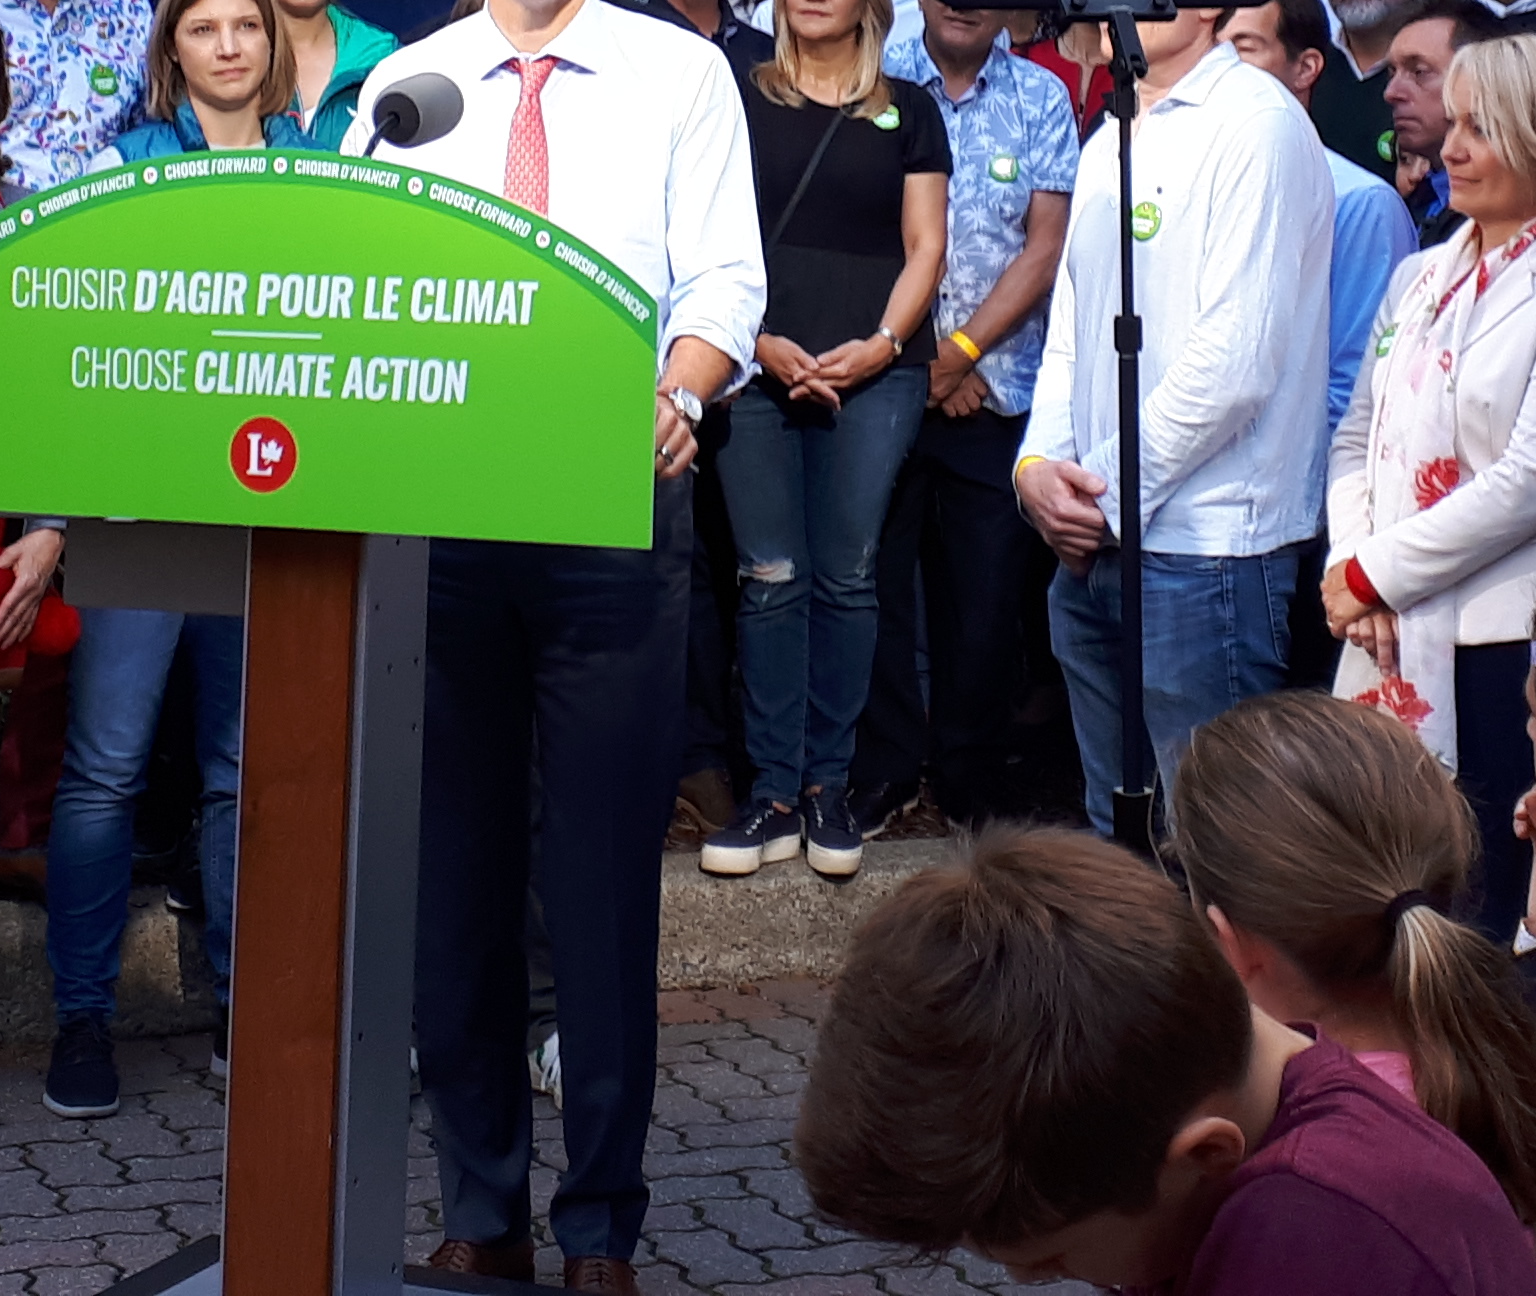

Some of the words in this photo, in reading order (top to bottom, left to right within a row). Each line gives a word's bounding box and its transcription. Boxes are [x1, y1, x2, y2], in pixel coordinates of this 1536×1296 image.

[38, 186, 81, 218] CHOISIR
[80, 171, 137, 202] D'AVANCER
[164, 158, 210, 181] CHOOSE
[210, 156, 267, 175] FORWARD
[294, 158, 340, 179] CHOISIR
[340, 165, 401, 190] D'AVANCER
[428, 182, 477, 215] CHOOSE
[474, 201, 532, 239] FORWARD
[11, 266, 127, 312] CHOISIR
[133, 269, 248, 317] D'AGIR
[257, 272, 355, 320] POUR
[363, 276, 403, 322] LE
[409, 277, 540, 326] CLIMAT
[553, 240, 599, 281] CHOISIR
[595, 272, 651, 324] D'AVANCER
[71, 345, 188, 393] CHOOSE
[194, 349, 335, 399] CLIMATE
[340, 355, 469, 404] ACTION
